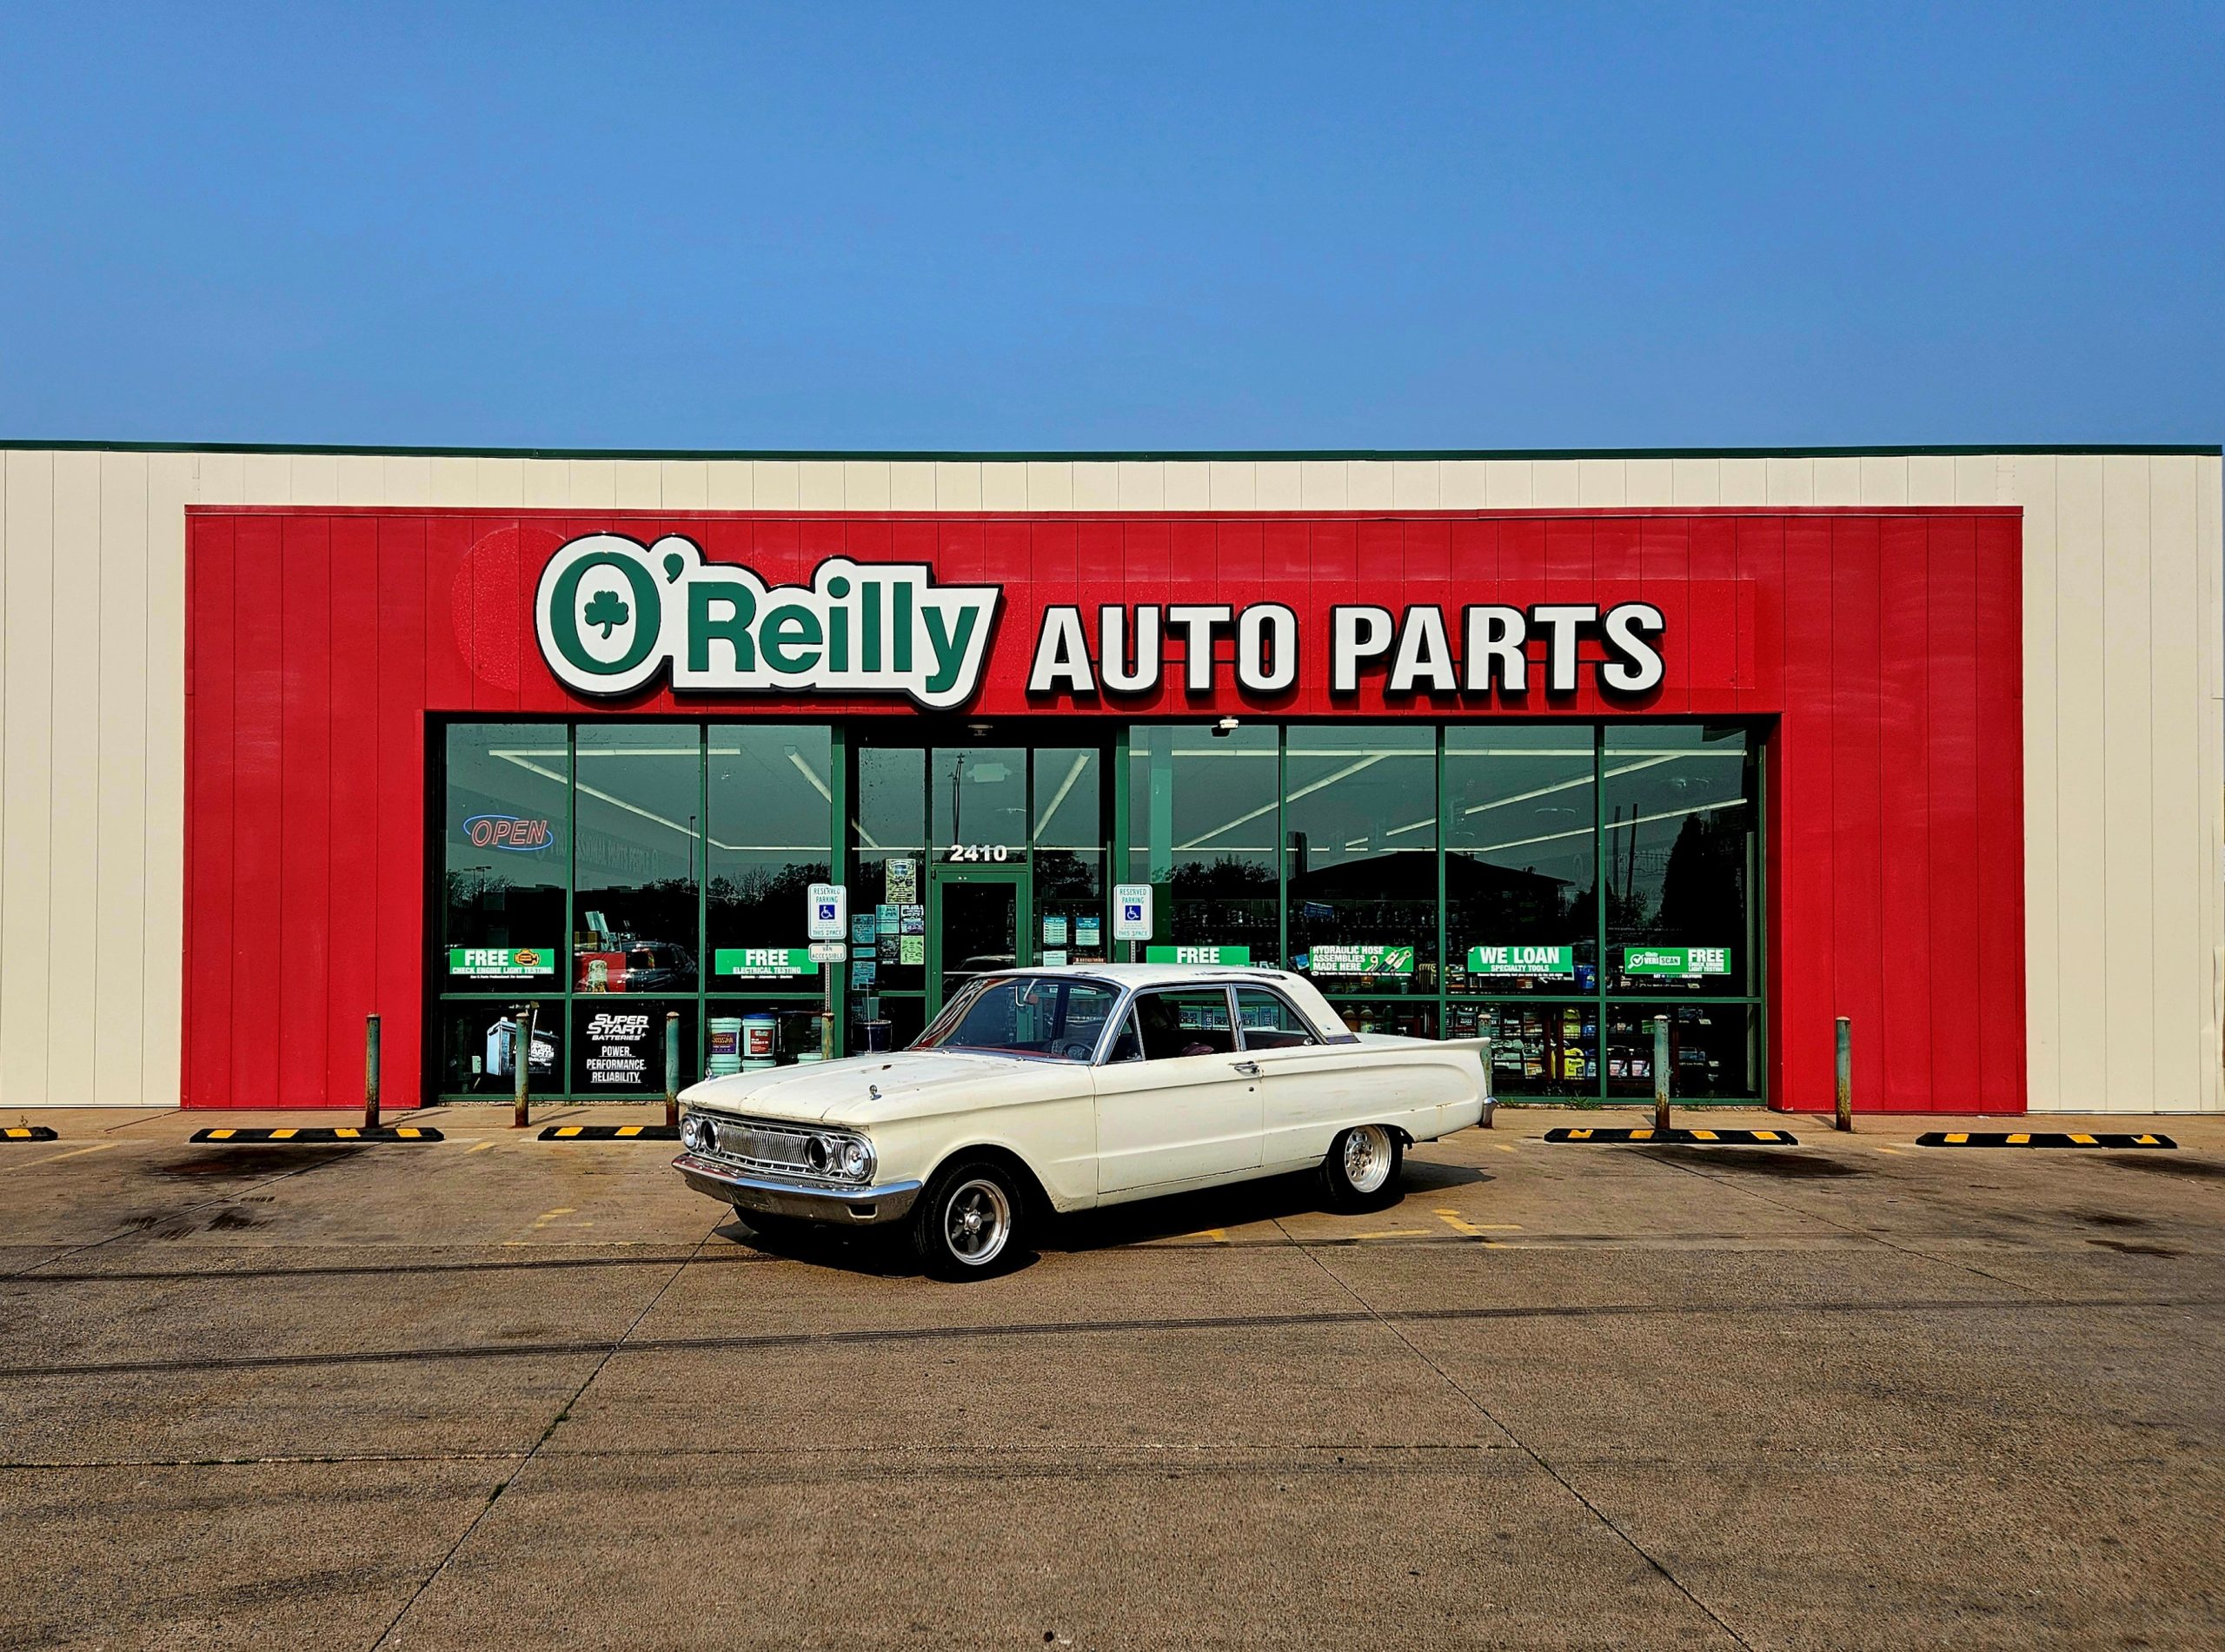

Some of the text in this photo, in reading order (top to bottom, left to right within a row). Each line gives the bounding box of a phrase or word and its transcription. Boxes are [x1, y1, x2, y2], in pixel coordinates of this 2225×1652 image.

[550, 551, 1664, 693] O'Reilly AUTO PARTS
[471, 819, 548, 847] OPEN
[949, 844, 1007, 862] 2410
[1177, 947, 1220, 964] FREE
[1312, 945, 1385, 955] HYDRAULIC HOSE
[1480, 946, 1560, 965] WE LOAN
[1688, 949, 1724, 963] FREE
[464, 949, 509, 966] FREE
[745, 949, 789, 966] FREE
[1312, 954, 1365, 963] ASSEMBLIES
[1312, 963, 1362, 972] MADE HERE
[594, 1013, 649, 1025] SUPER
[586, 1023, 650, 1035] START
[601, 1045, 633, 1057] POWER.
[586, 1058, 648, 1071] PERFORMANCE.
[592, 1071, 641, 1083] RELIABILITY.
